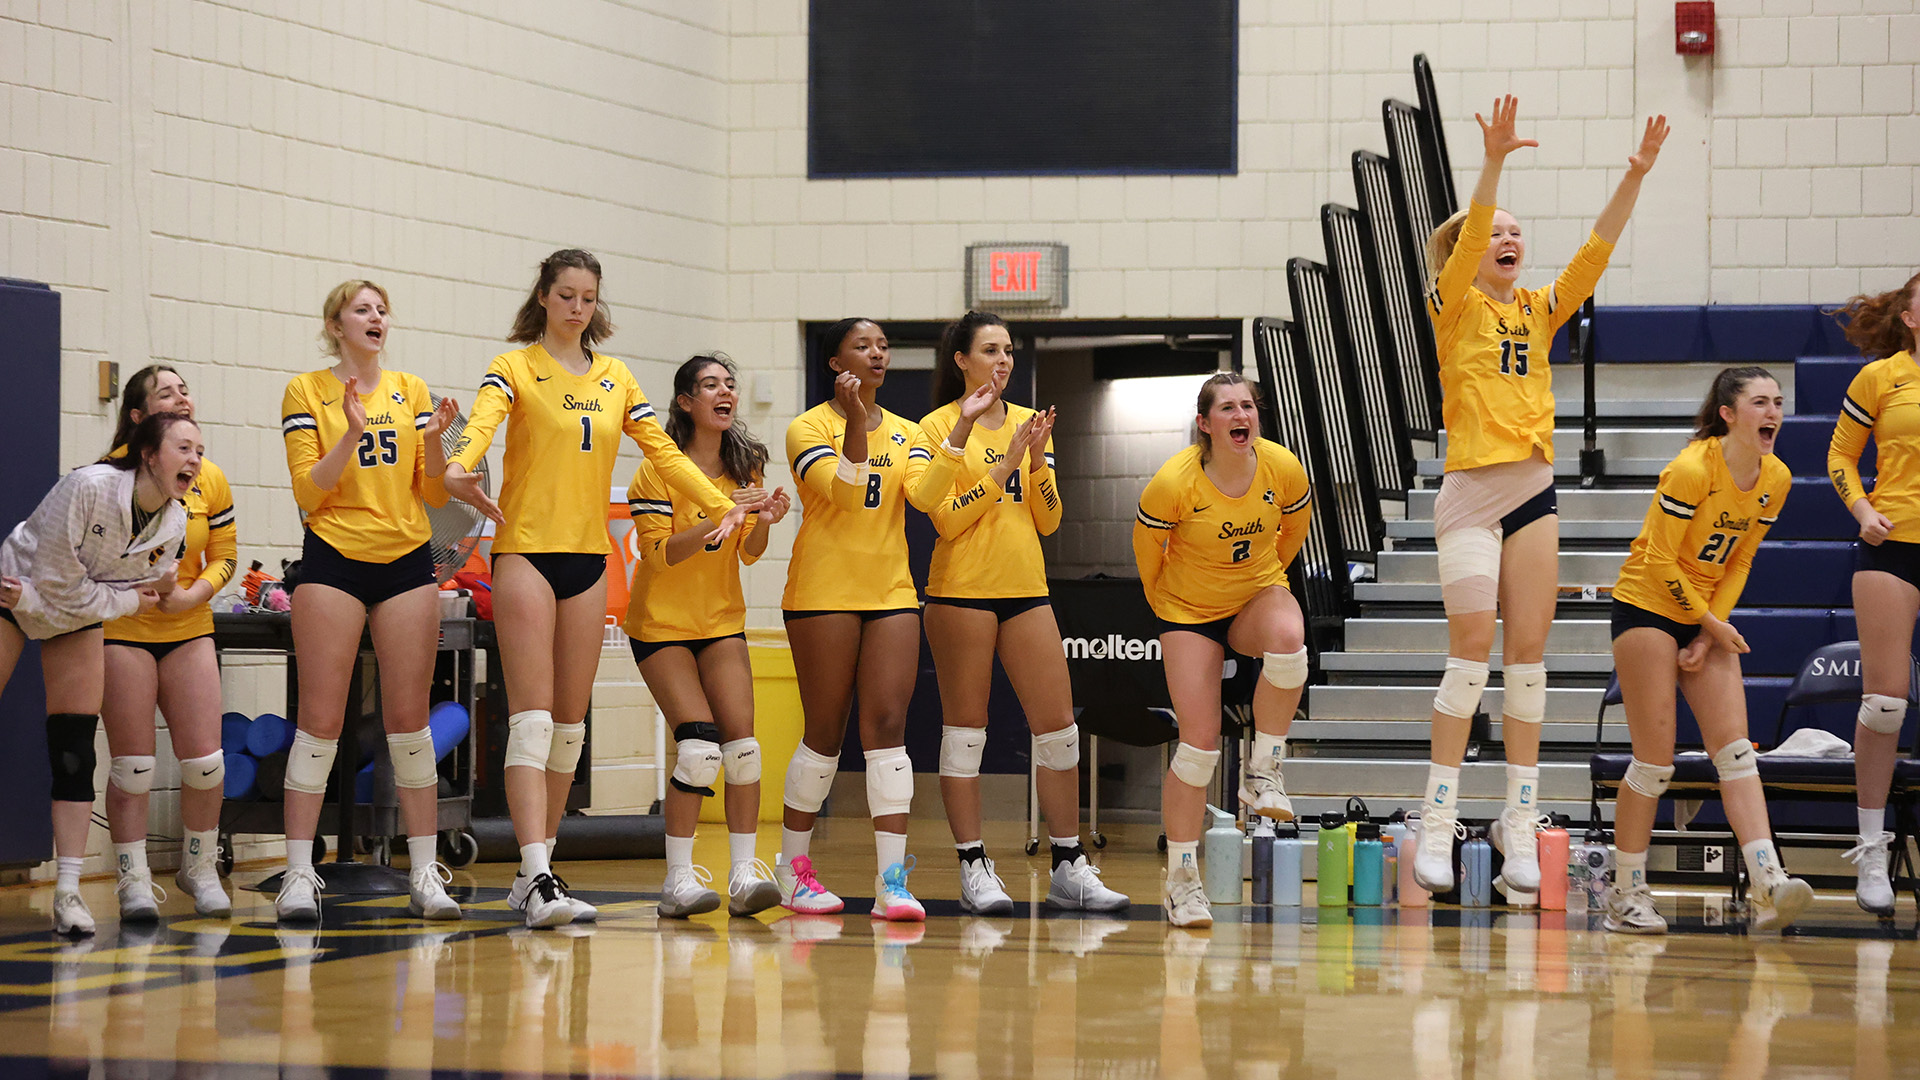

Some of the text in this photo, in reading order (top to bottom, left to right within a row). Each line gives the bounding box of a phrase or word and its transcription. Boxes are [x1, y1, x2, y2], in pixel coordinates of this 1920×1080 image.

[990, 252, 1042, 292] EXIT
[1499, 339, 1529, 377] 15
[562, 394, 603, 412] Smith
[366, 411, 395, 426] mith
[580, 415, 592, 452] 1
[357, 429, 398, 468] 25
[864, 472, 882, 509] 8
[952, 484, 986, 512] FAMILY
[1217, 517, 1265, 540] Smith
[1231, 539, 1252, 564] 2
[1697, 532, 1740, 565] 21
[1062, 634, 1162, 661] molten
[1811, 657, 1861, 677] SMI
